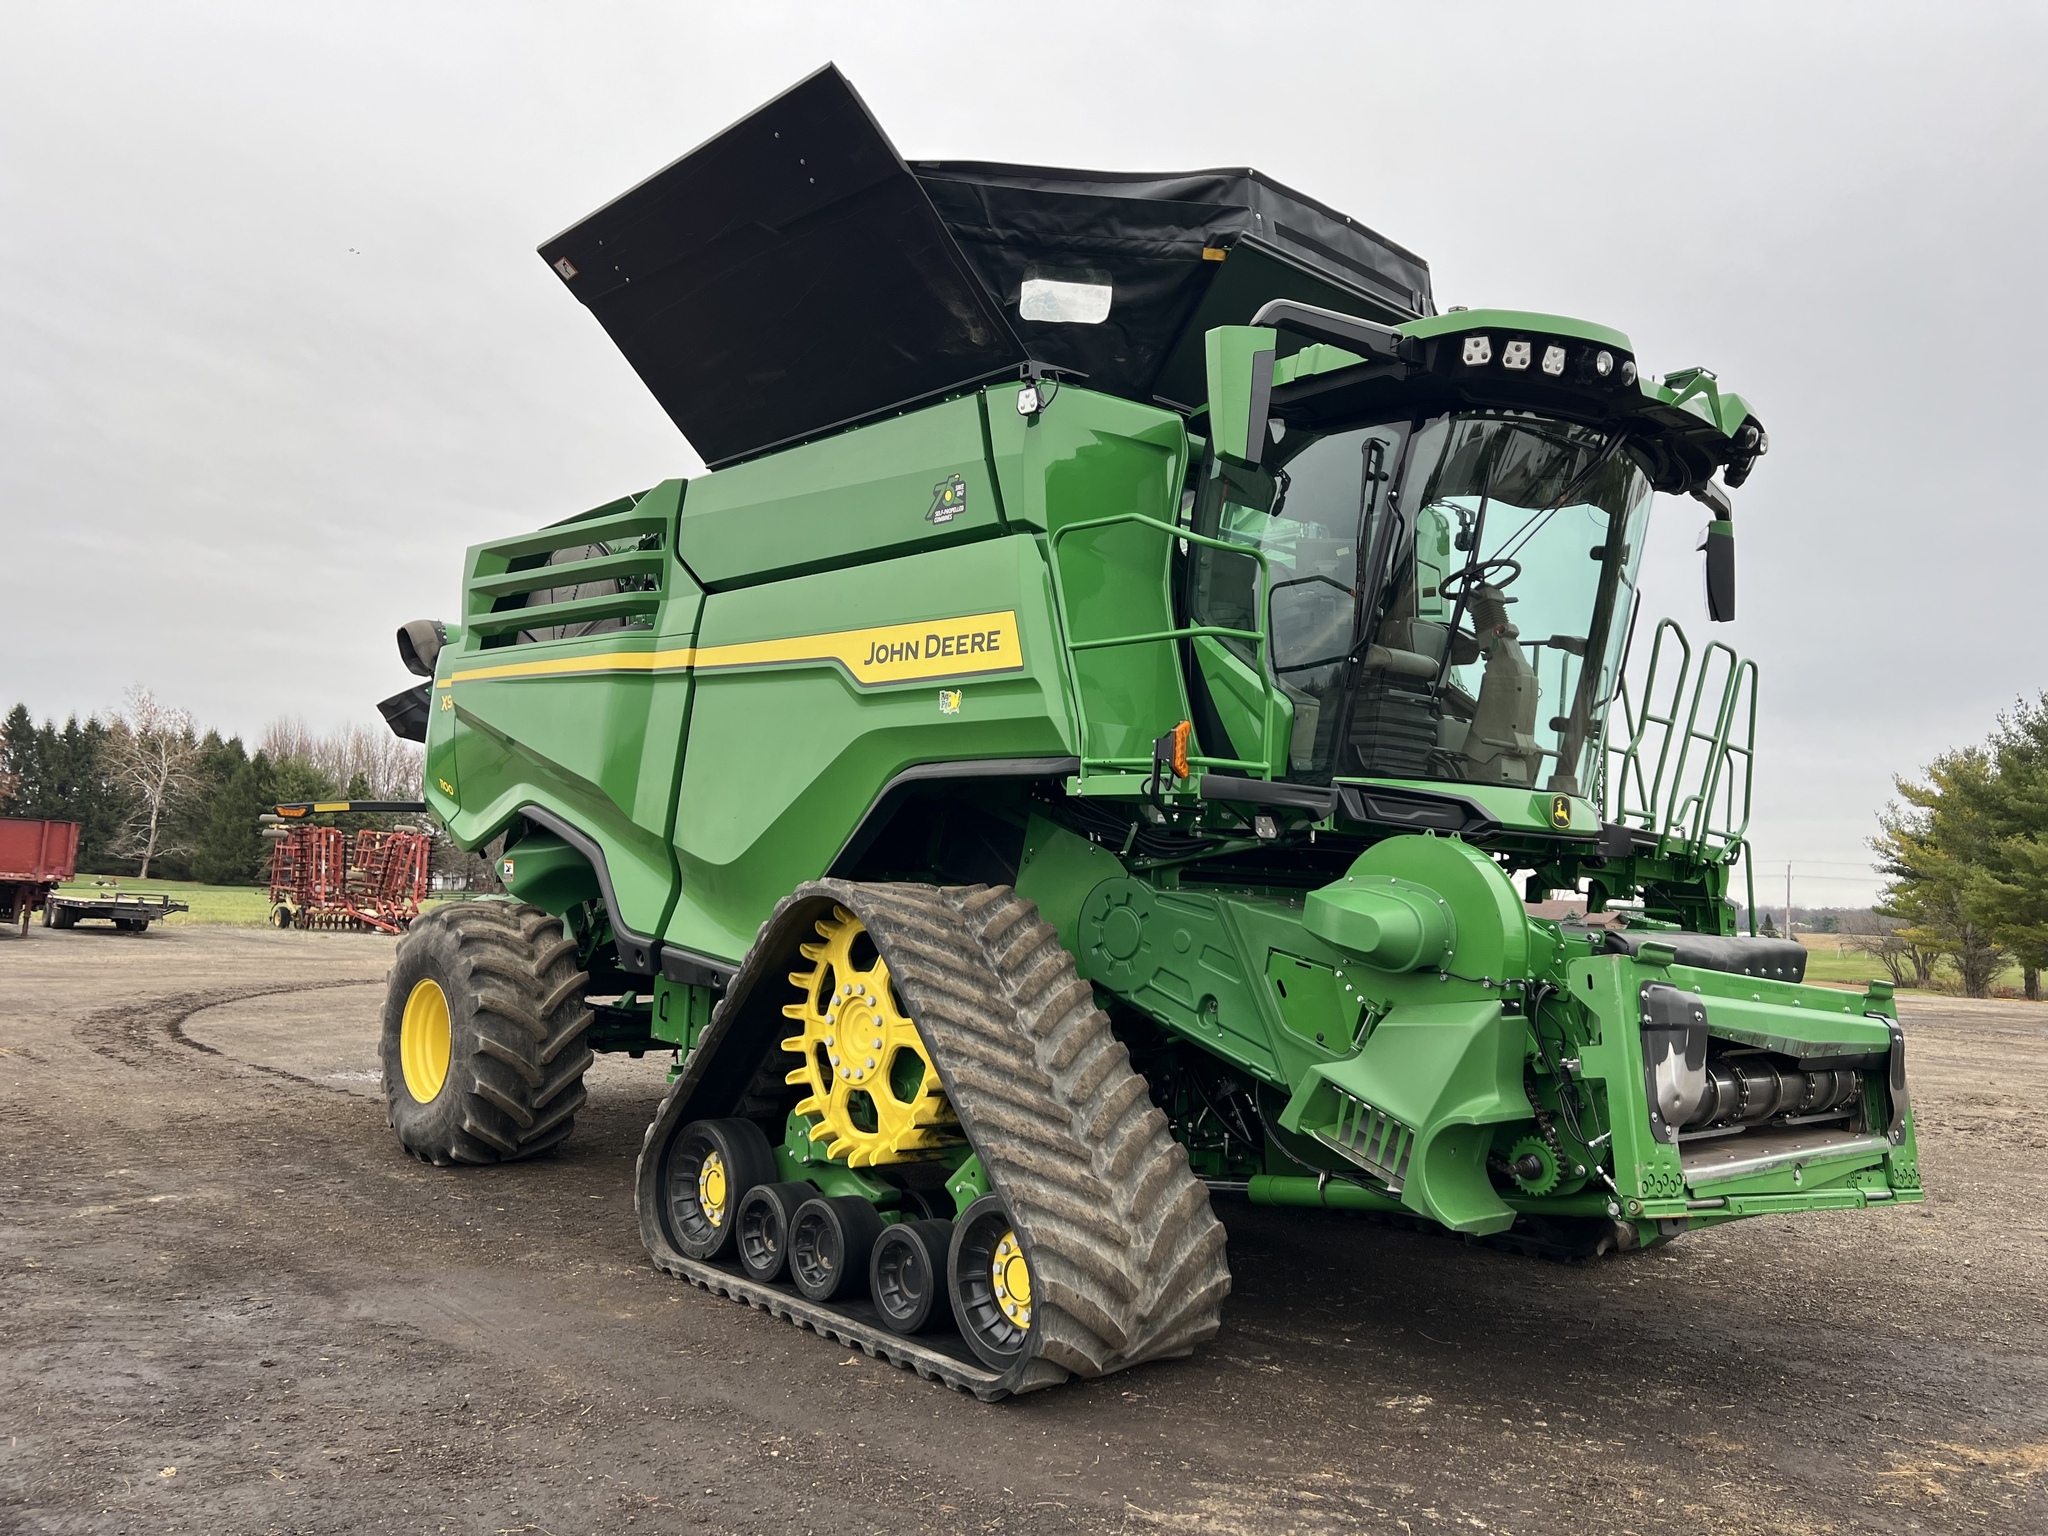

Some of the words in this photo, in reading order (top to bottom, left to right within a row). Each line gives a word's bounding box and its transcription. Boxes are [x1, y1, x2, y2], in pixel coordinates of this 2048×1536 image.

[864, 640, 919, 665] JOHN
[925, 630, 1001, 658] DEERE
[441, 694, 453, 711] X9
